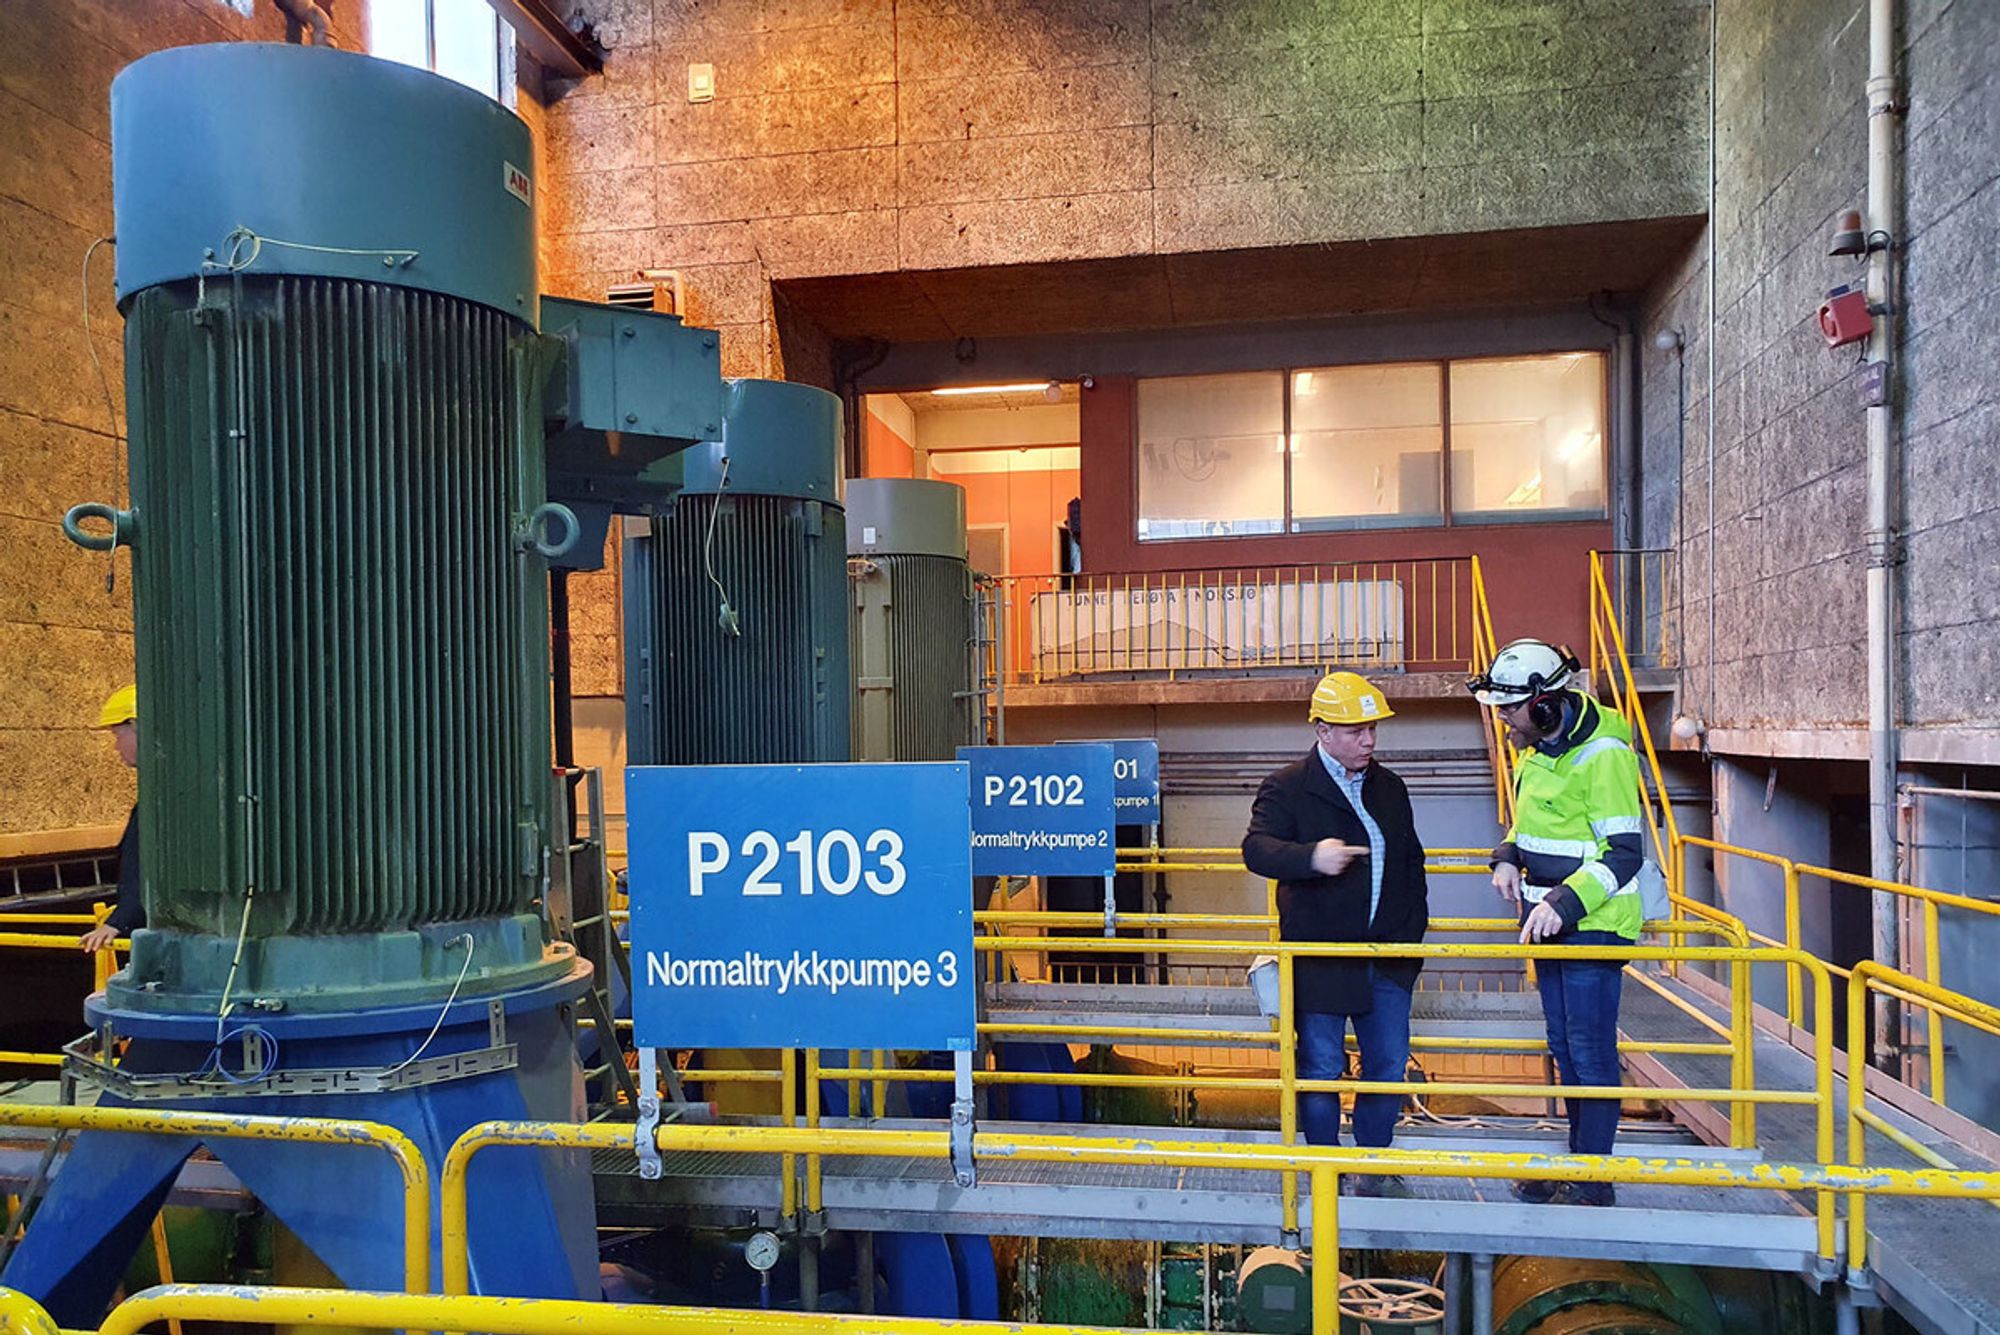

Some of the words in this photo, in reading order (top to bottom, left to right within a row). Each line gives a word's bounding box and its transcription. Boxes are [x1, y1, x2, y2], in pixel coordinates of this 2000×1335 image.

[510, 169, 528, 197] ABB
[984, 776, 1005, 806] P
[1008, 775, 1085, 806] 2102
[1113, 796, 1149, 808] pumpe
[971, 830, 1096, 850] ormaltrykkpumpe
[1098, 830, 1108, 847] 2
[688, 831, 730, 896] P
[741, 829, 907, 896] 2103
[646, 950, 931, 994] Normaltrykkpumpe
[936, 950, 958, 987] 3
